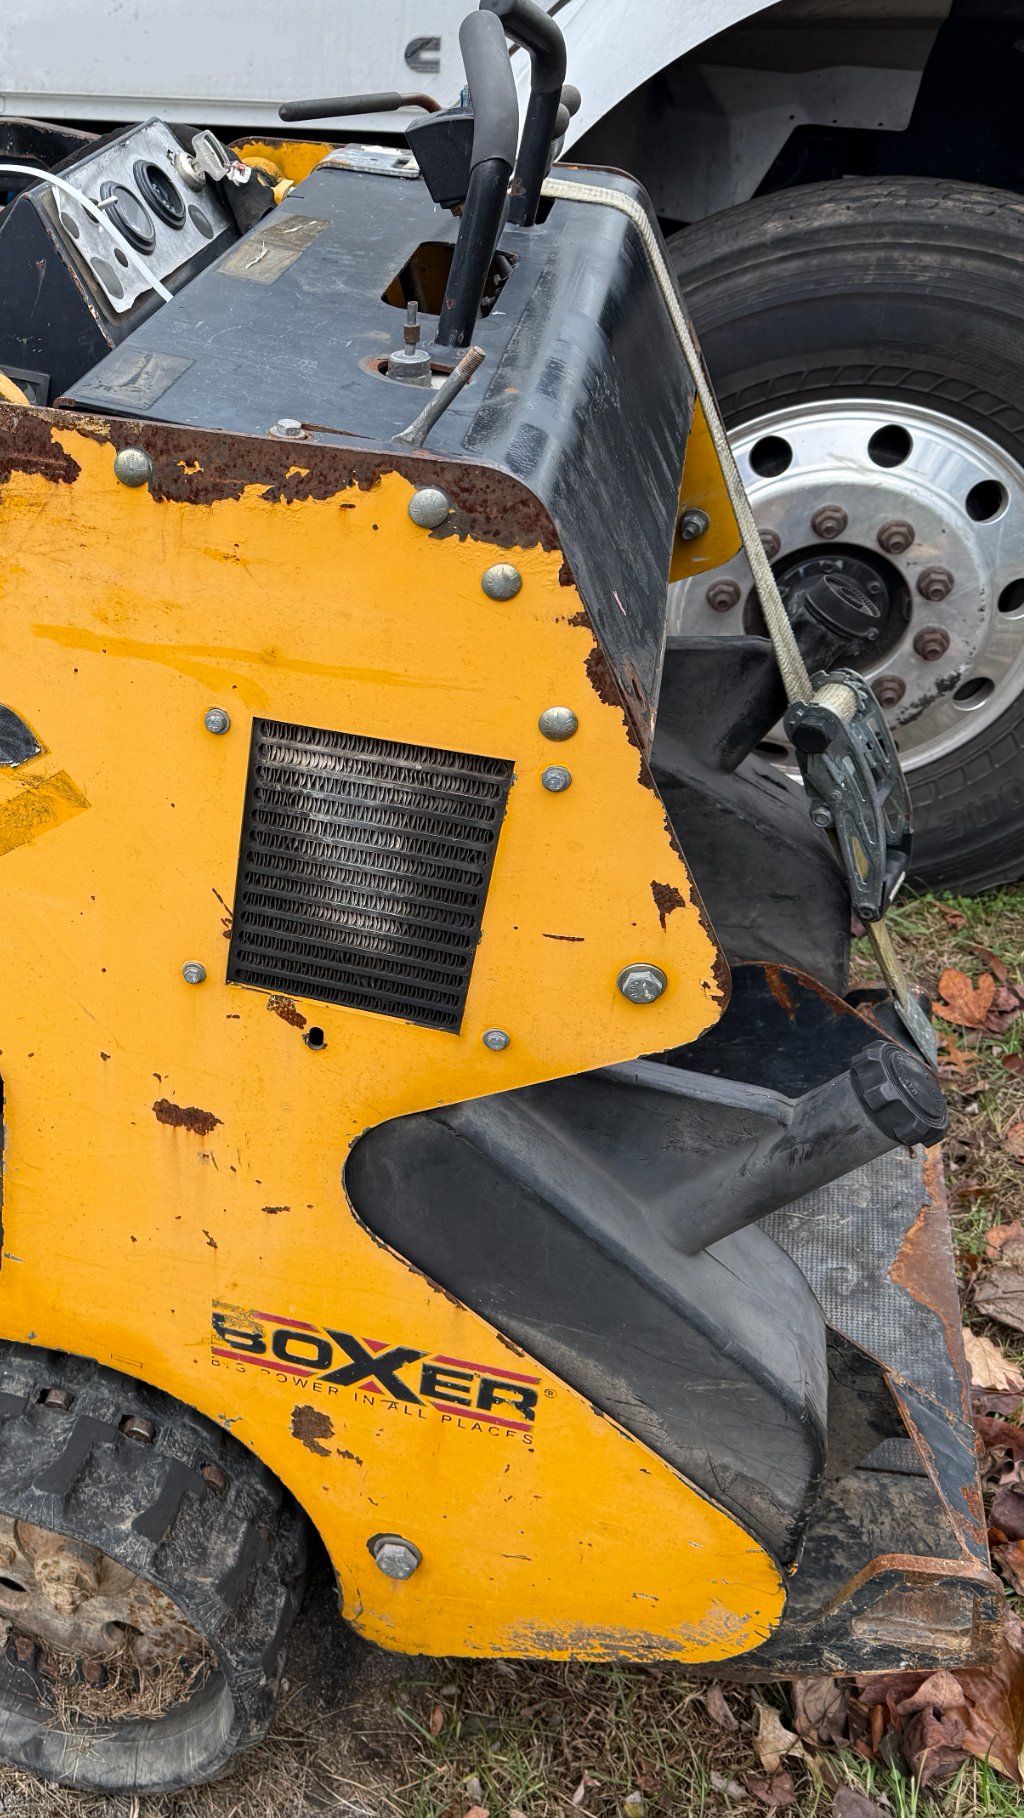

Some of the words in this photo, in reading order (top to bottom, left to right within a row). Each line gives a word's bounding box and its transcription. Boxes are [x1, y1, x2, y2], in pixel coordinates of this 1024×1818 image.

[212, 1312, 538, 1421] BOXER
[354, 1392, 375, 1406] IN
[387, 1401, 427, 1419] ALL
